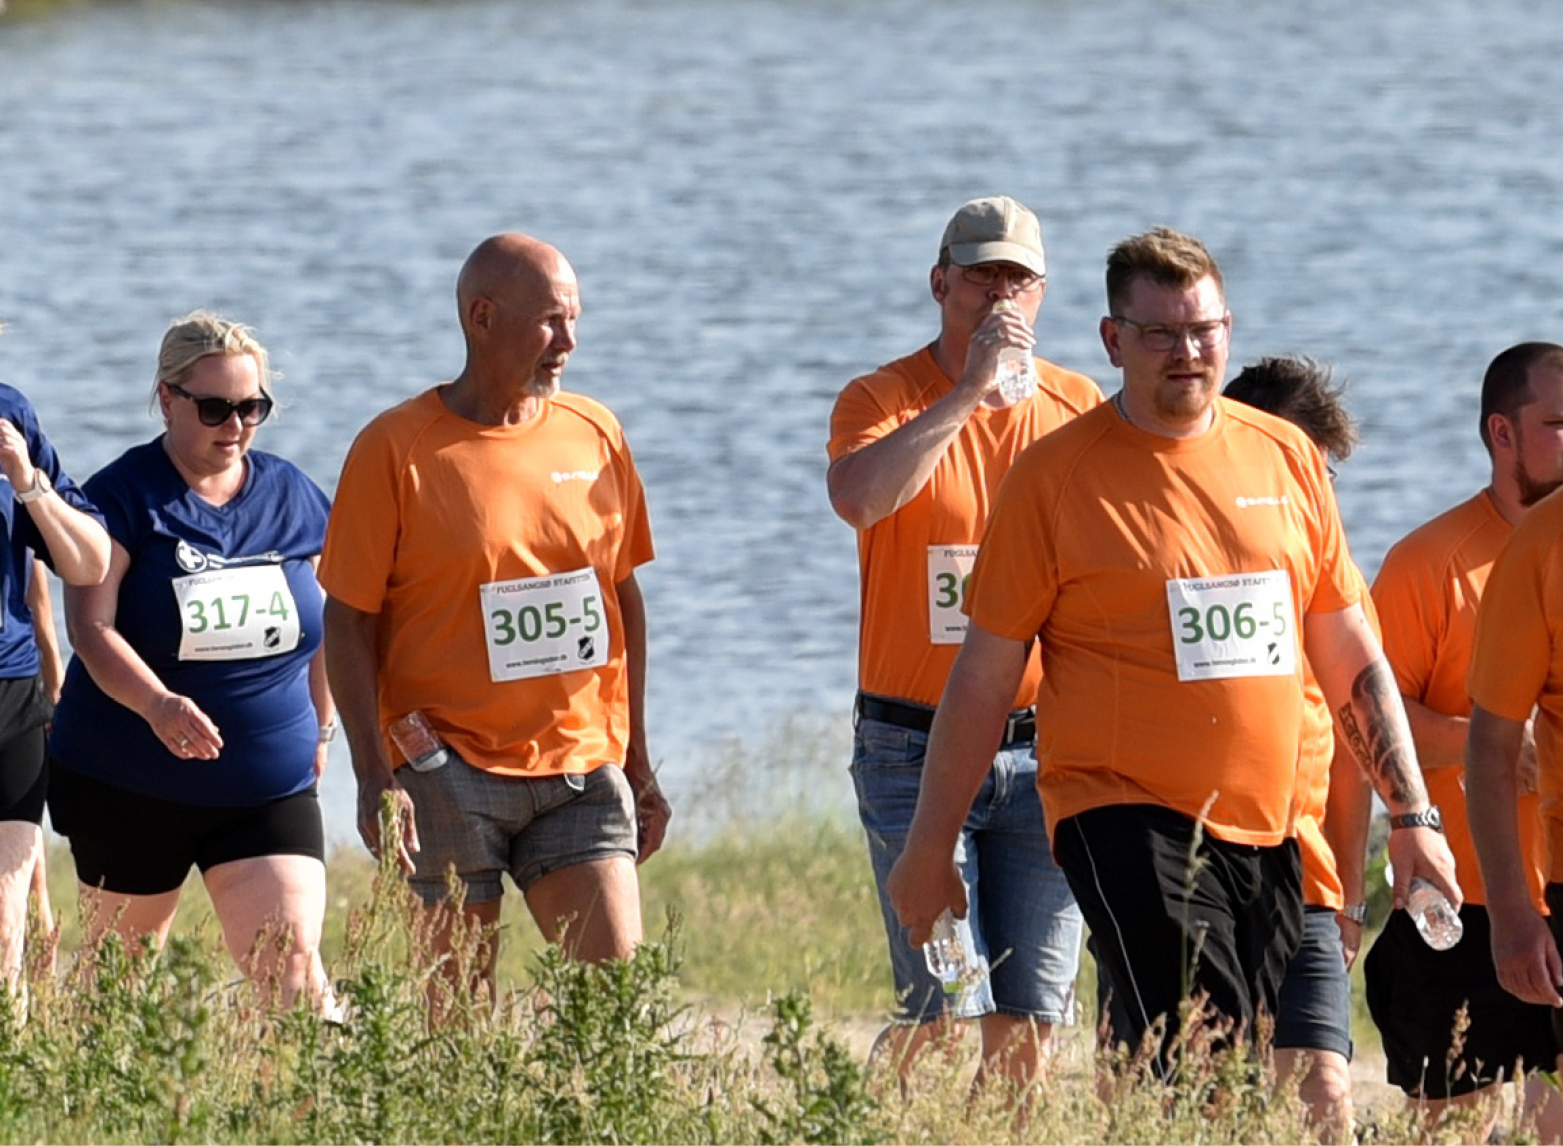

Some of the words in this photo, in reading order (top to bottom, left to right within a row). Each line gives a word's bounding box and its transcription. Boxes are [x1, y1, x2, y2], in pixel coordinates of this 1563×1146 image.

[186, 591, 290, 634] 317-4
[491, 595, 601, 646] 305-5
[1178, 601, 1287, 644] 306-5
